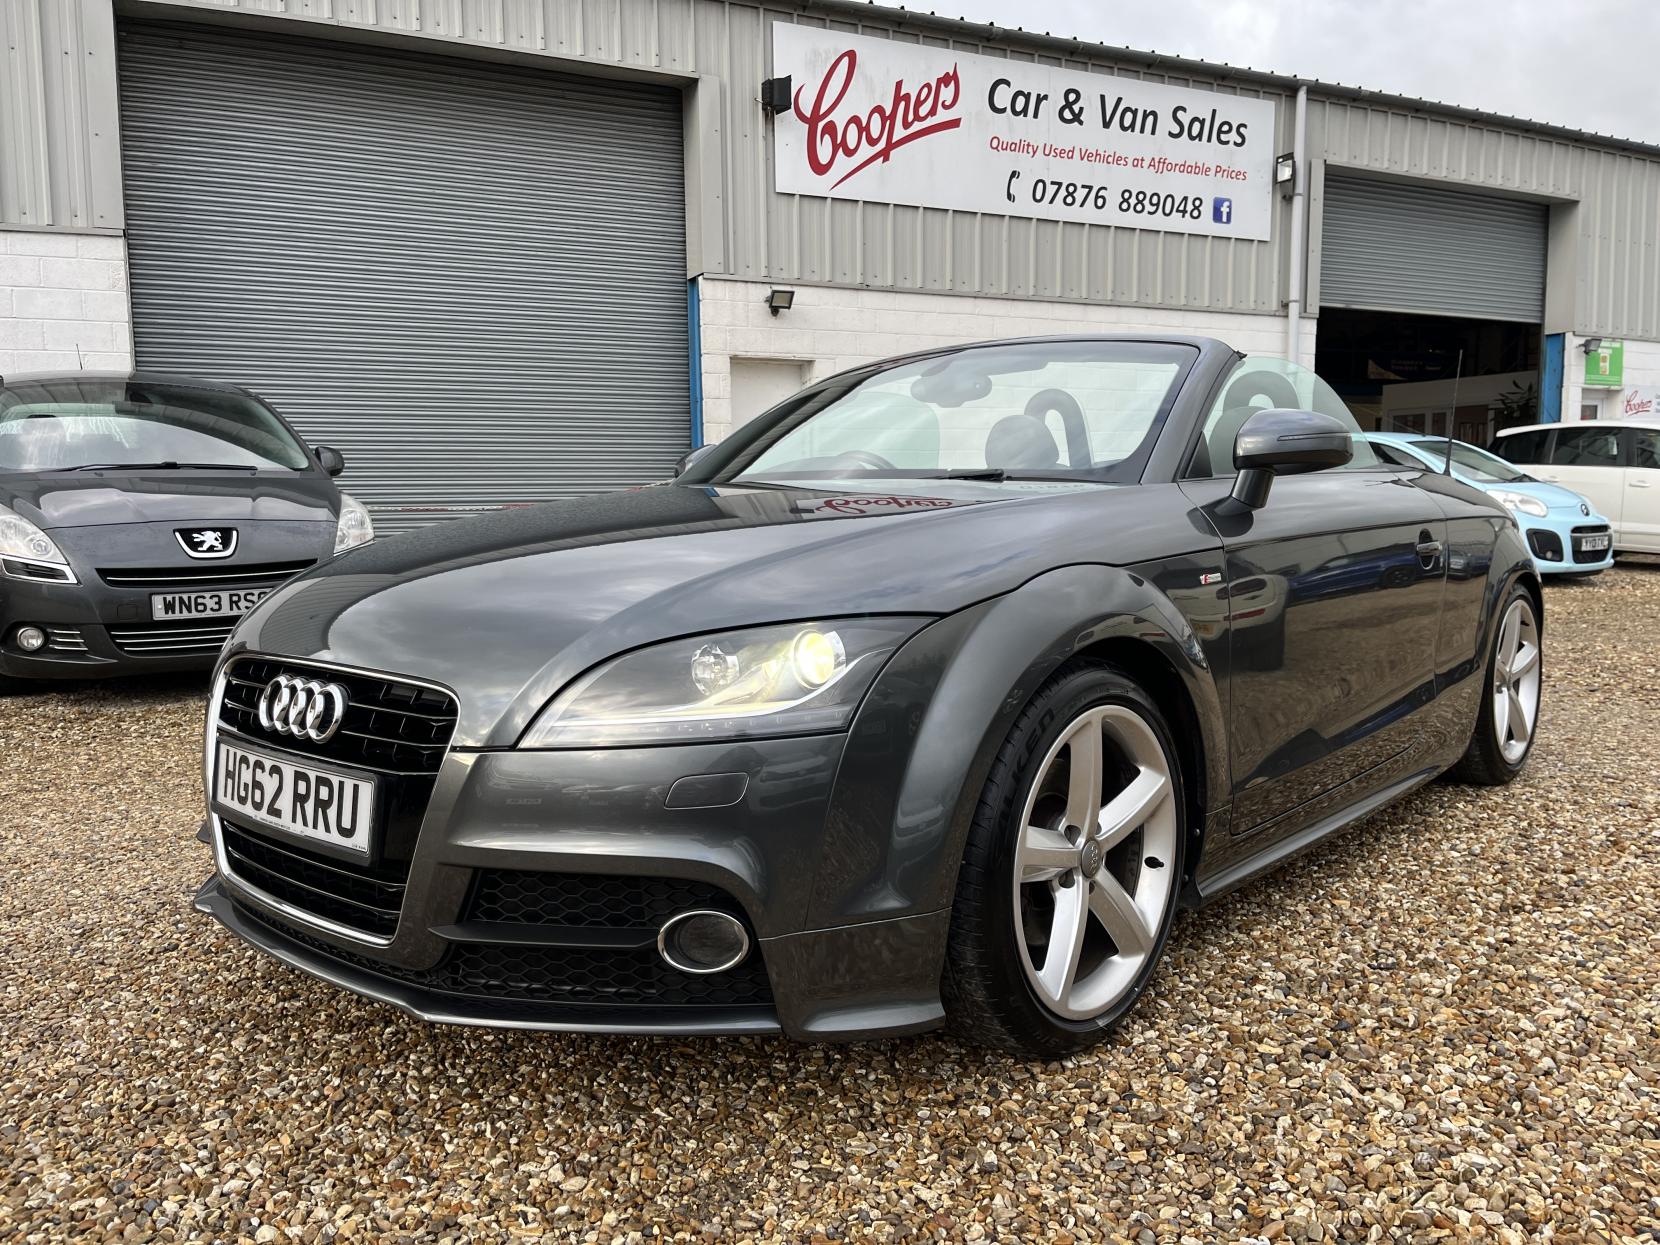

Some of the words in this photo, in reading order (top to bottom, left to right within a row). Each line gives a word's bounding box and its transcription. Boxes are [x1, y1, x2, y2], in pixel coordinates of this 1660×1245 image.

[793, 49, 960, 176] Coopers
[988, 78, 1049, 119] Car
[1057, 88, 1085, 127] &
[1100, 94, 1159, 136] Van
[1168, 105, 1248, 147] Sales
[990, 136, 1039, 159] Quality
[1042, 143, 1075, 160] Used
[1079, 147, 1129, 167] Vehicles
[1132, 156, 1145, 169] at
[1147, 157, 1212, 177] Affordable
[1214, 165, 1248, 181] Prices
[1032, 179, 1108, 210] 07876
[1118, 188, 1203, 220] 889048
[162, 595, 223, 615] WN63
[223, 747, 284, 820] HG62
[291, 770, 360, 840] RRU
